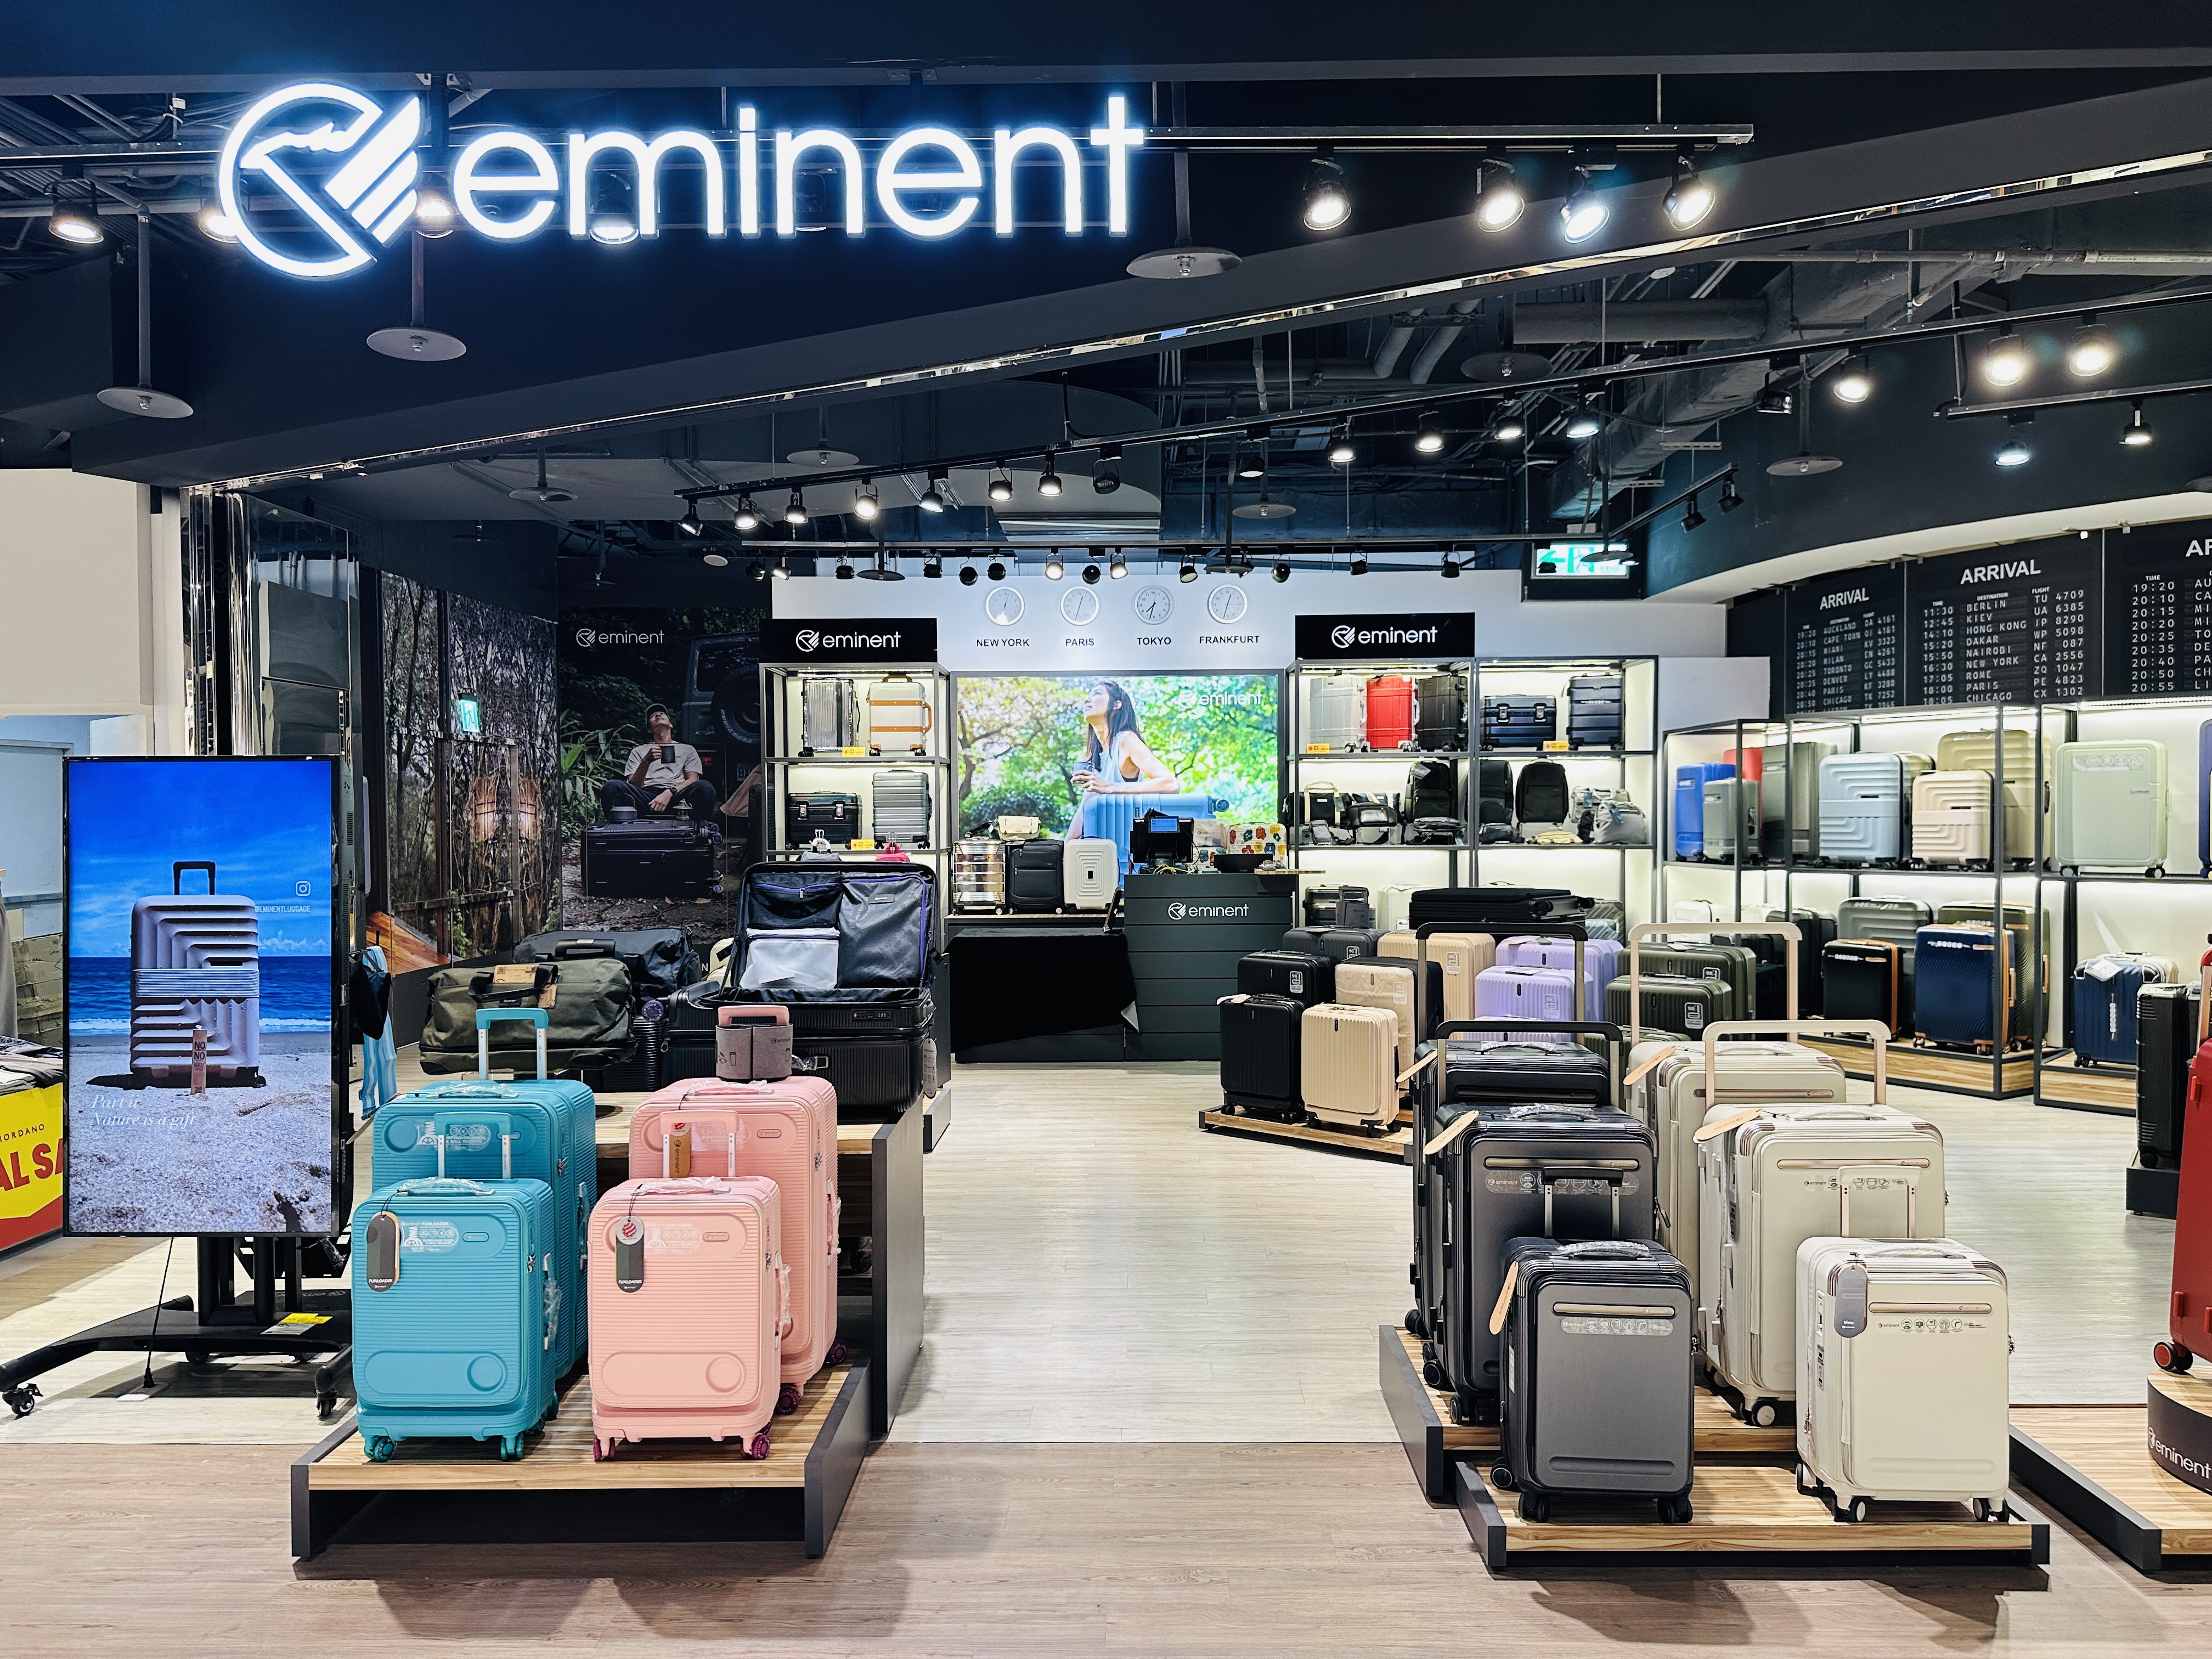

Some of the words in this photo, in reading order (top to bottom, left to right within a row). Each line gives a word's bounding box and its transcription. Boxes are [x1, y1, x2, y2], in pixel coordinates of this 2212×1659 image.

[453, 95, 1146, 240] eminent
[1960, 559, 2041, 584] ARRIVAL
[2133, 582, 2174, 593] 19:20
[1820, 588, 1869, 610] ARRIVAL
[1977, 592, 2008, 601] DESTINATION
[2132, 594, 2174, 606] 20:10
[1924, 606, 1953, 617] 11:30
[1967, 600, 2006, 612] BERLIN
[2034, 594, 2047, 603] TU
[2056, 590, 2083, 601] 4709
[1924, 617, 1953, 628] 12:45
[1966, 613, 1993, 623] KIEV
[2034, 606, 2047, 616] UA
[2056, 602, 2083, 613] 6385
[2132, 607, 2174, 618] 20:15
[1824, 622, 1857, 635] AUCKLAND
[1924, 629, 1953, 639] 14:10
[1966, 624, 1993, 635] HONG
[1999, 620, 2027, 631] KONG
[2056, 614, 2083, 625] 8290
[2132, 619, 2174, 630] 20:20
[599, 630, 665, 644] eminent
[823, 631, 901, 648] eminent
[1137, 637, 1172, 646] TOKYO
[1199, 635, 1260, 645] FRANKFURT
[1358, 626, 1438, 644] eminent
[1824, 635, 1839, 645] CAPE
[1923, 640, 1953, 651] 15:20
[1966, 635, 1999, 646] DAKAR
[2034, 630, 2047, 640] WP
[2056, 626, 2083, 637] 5098
[2132, 632, 2174, 642] 20:25
[977, 639, 1000, 647] NEW
[1002, 639, 1030, 647] YORK
[1065, 638, 1094, 646] PARIS
[1824, 645, 1843, 654] MIAMI
[1923, 651, 1953, 662] 15:50
[1966, 646, 2011, 657] NAIROBI
[2034, 642, 2046, 651] NF
[2063, 638, 2083, 648] 087
[2132, 645, 2174, 655] 20:35
[1923, 662, 1953, 673] 16:30
[1966, 659, 1985, 669] NEW
[1993, 656, 2019, 667] YORK
[2034, 653, 2047, 663] CA
[2056, 650, 2083, 661] 2556
[2132, 657, 2174, 668] 20:40
[1824, 664, 1852, 675] TORONTO
[1923, 674, 1953, 683] 17:05
[1966, 670, 1991, 680] ROME
[2034, 665, 2047, 675] ZQ
[2056, 662, 2083, 673] 1047
[2132, 670, 2174, 680] 20:50
[1823, 675, 1848, 686] DENVER
[1864, 672, 1873, 680] LY
[1923, 685, 1953, 695] 18:00
[1966, 681, 1998, 691] PARIS
[2034, 678, 2046, 686] PE
[2055, 674, 2083, 685] 4823
[1823, 686, 1843, 696] PARIS
[2132, 682, 2174, 692] 20:55
[1199, 690, 1263, 706] eminent
[1823, 695, 1852, 706] CHICAGO
[1966, 692, 2012, 703] CHICAGO
[2034, 689, 2046, 698] CX
[2056, 686, 2083, 697] 1302
[1188, 904, 1249, 918] eminent
[194, 1041, 206, 1049] NO
[194, 1052, 205, 1060] NO
[91, 1094, 124, 1109] Part
[94, 1112, 141, 1125] Nature
[143, 1113, 154, 1125] is
[157, 1116, 166, 1125] a
[169, 1112, 195, 1130] gift
[0, 1124, 44, 1142] IORDANO
[2155, 1439, 2211, 1479] eminent
